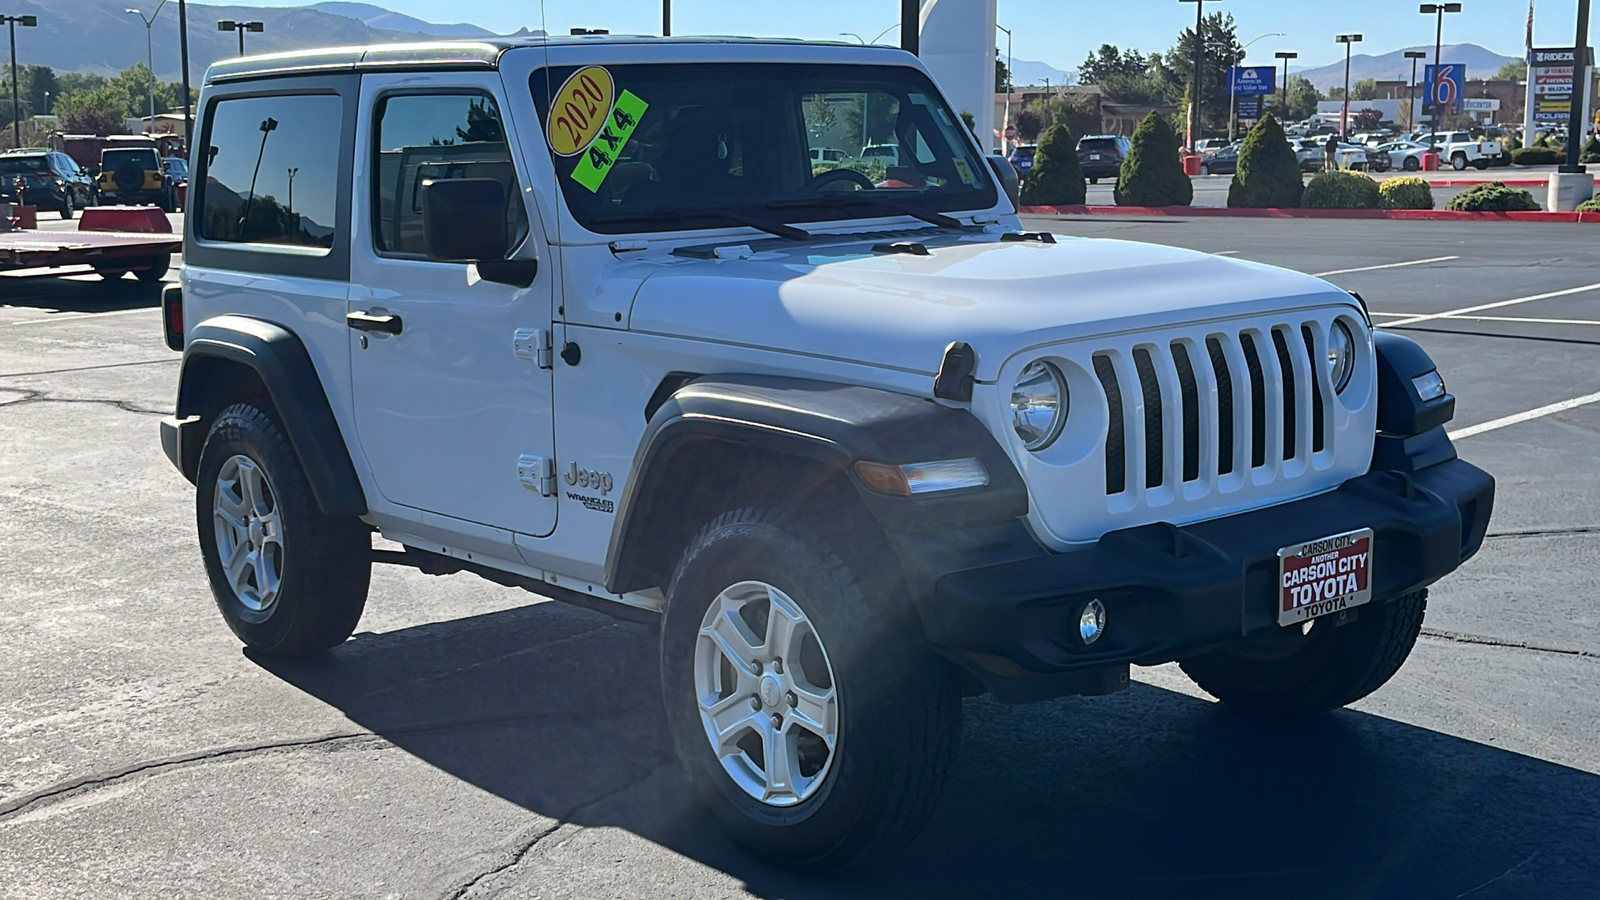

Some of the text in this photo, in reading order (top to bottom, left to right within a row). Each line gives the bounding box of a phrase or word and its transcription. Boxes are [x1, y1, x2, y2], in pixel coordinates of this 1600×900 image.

[1431, 65, 1457, 105] 6
[557, 74, 604, 148] 2020
[563, 461, 613, 496] Jeep
[566, 491, 614, 507] WRANGLER
[1302, 535, 1352, 556] CARSON CITY
[1311, 551, 1339, 564] ANOTHER
[1283, 552, 1367, 588] CARSON CITY
[1290, 572, 1358, 608] TOYOTA
[1304, 597, 1347, 618] TOYOTA
